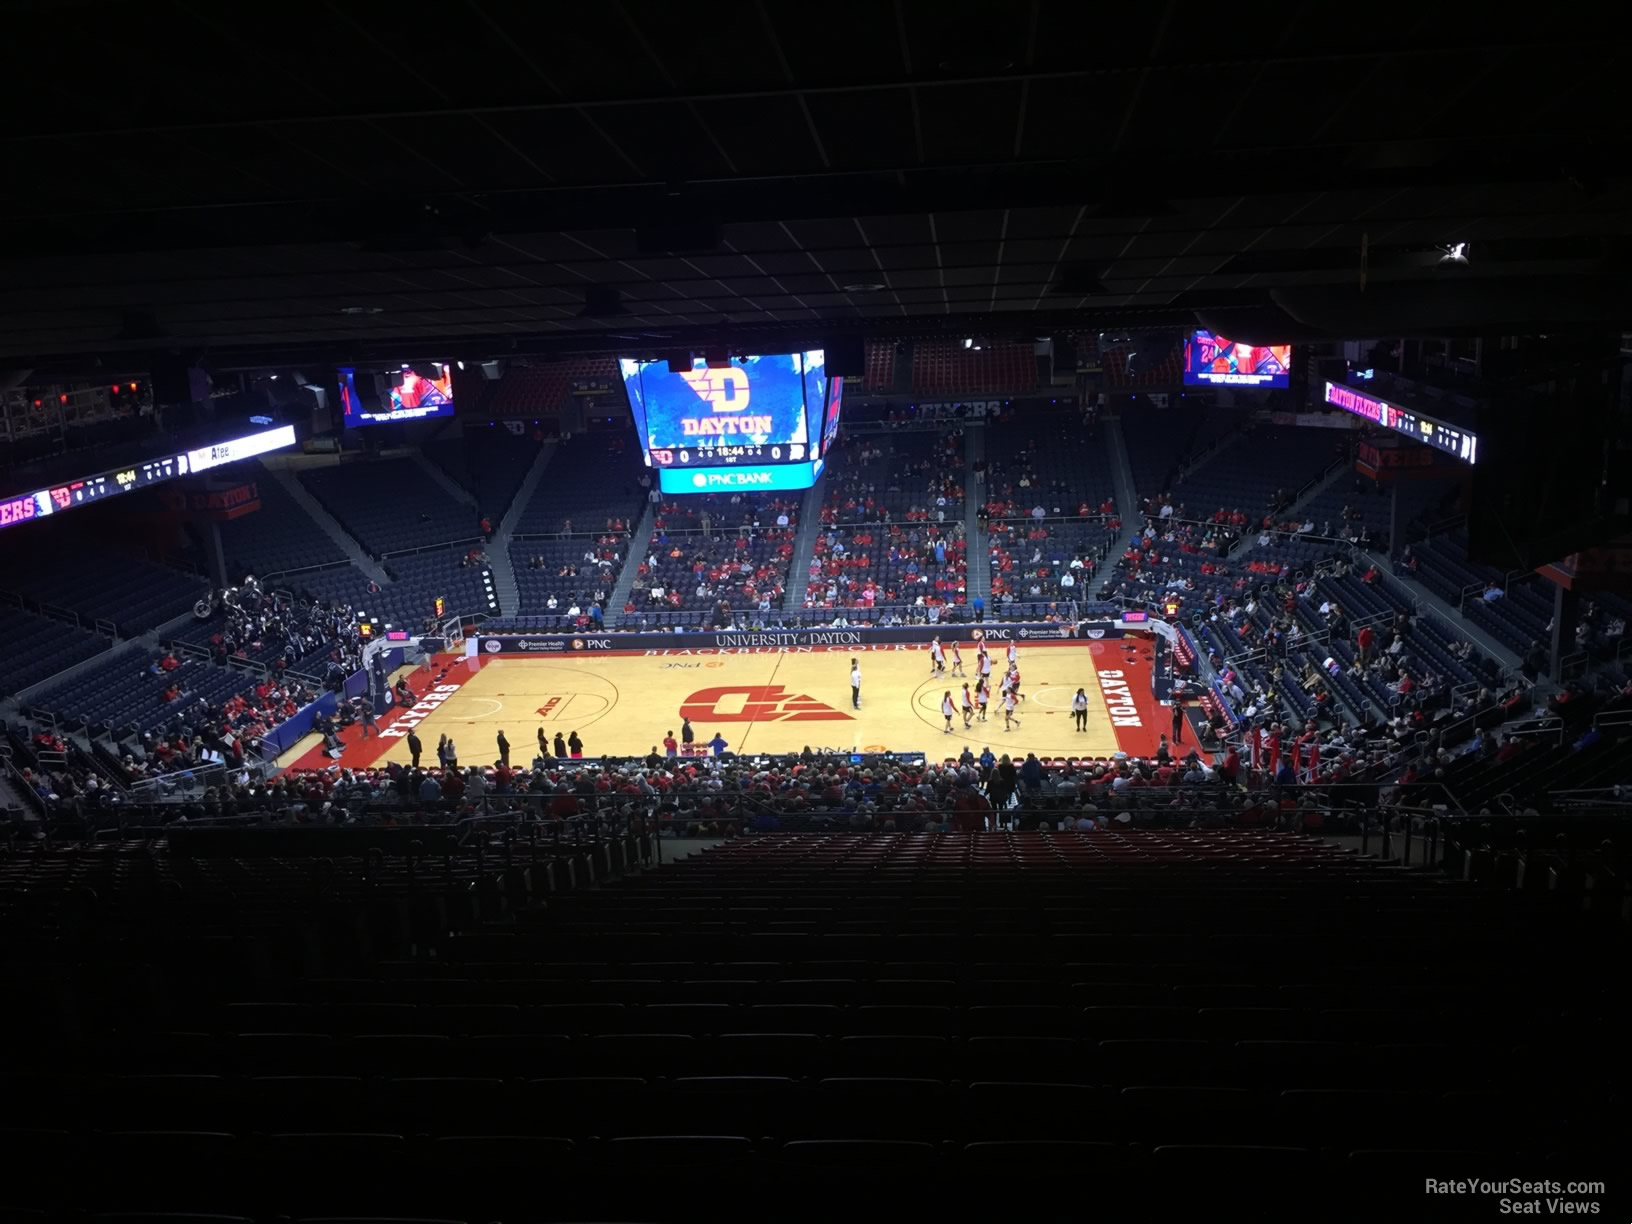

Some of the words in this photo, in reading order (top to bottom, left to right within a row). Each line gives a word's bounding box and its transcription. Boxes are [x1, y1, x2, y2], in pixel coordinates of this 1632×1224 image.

[1201, 345, 1215, 363] 24
[681, 415, 772, 435] DAYTON
[680, 450, 689, 463] 0
[717, 446, 744, 456] 18:44
[771, 447, 781, 459] 0
[0, 497, 35, 526] ERS
[715, 632, 799, 647] UNIVERSITY
[800, 634, 807, 643] of
[810, 631, 861, 645] DAYTON
[985, 629, 1011, 639] PNC
[587, 639, 612, 649] PNC
[643, 646, 813, 657] BLACKBURN
[827, 643, 929, 652] COURT
[1098, 669, 1143, 727] DAYTON
[378, 684, 461, 738] FLYERS
